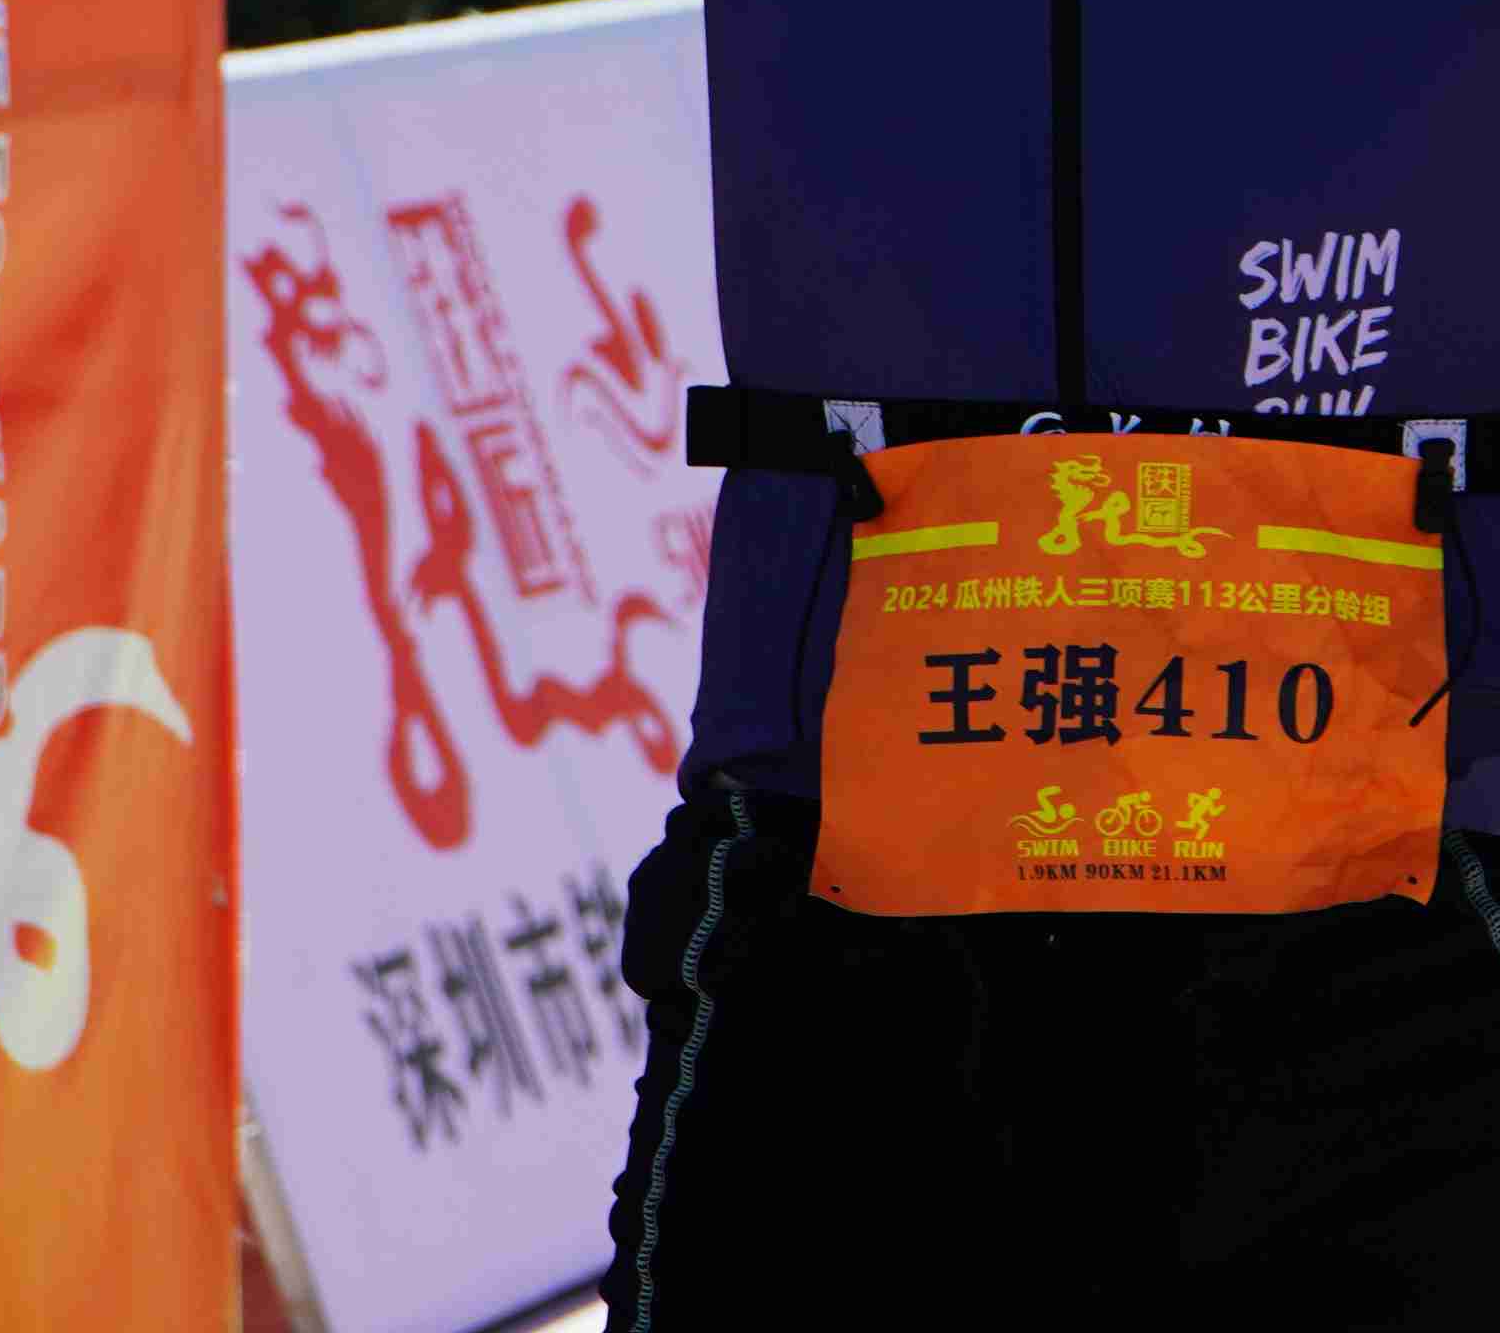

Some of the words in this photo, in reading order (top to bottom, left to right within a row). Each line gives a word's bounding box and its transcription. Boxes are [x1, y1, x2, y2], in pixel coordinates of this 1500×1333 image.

[1238, 228, 1401, 310] SWIM
[1243, 305, 1395, 388] BIKE
[882, 583, 950, 614] 2024
[917, 642, 1336, 747] 王强410
[1016, 839, 1080, 859] SWIM
[1102, 839, 1157, 859] BIKE
[1172, 840, 1225, 860] RUN
[1018, 863, 1077, 882] 1.9KM
[1083, 862, 1146, 882] 90KM
[1151, 864, 1228, 883] 21.1KM
